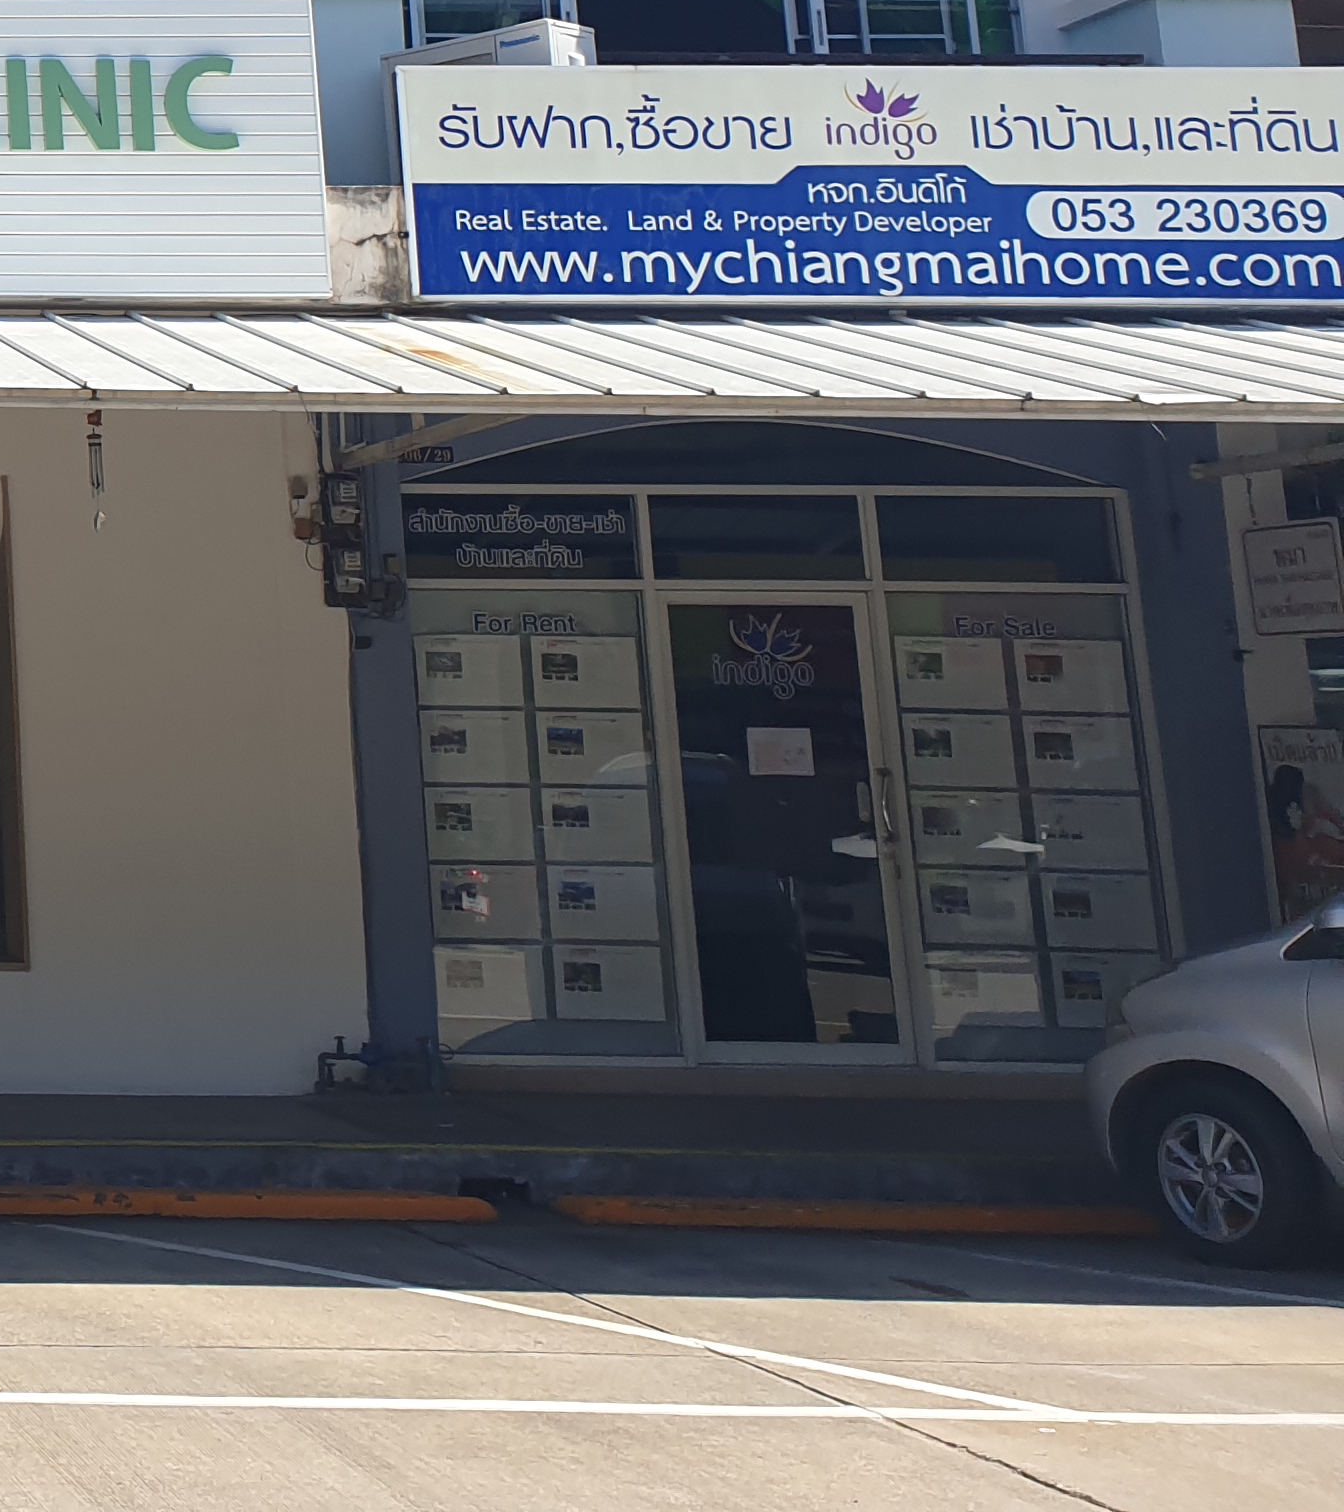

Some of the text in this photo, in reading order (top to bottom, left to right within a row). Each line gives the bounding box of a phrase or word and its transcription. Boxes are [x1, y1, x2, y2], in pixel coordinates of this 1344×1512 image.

[826, 117, 937, 159] indigo
[456, 209, 992, 237] Real Estate. Land & Property Developer
[1052, 198, 1327, 233] 053 230369
[461, 239, 1341, 296] www.mychiangmaihome.com
[473, 613, 578, 633] For Rent
[954, 615, 1057, 637] For Sale
[712, 654, 815, 700] indigo
